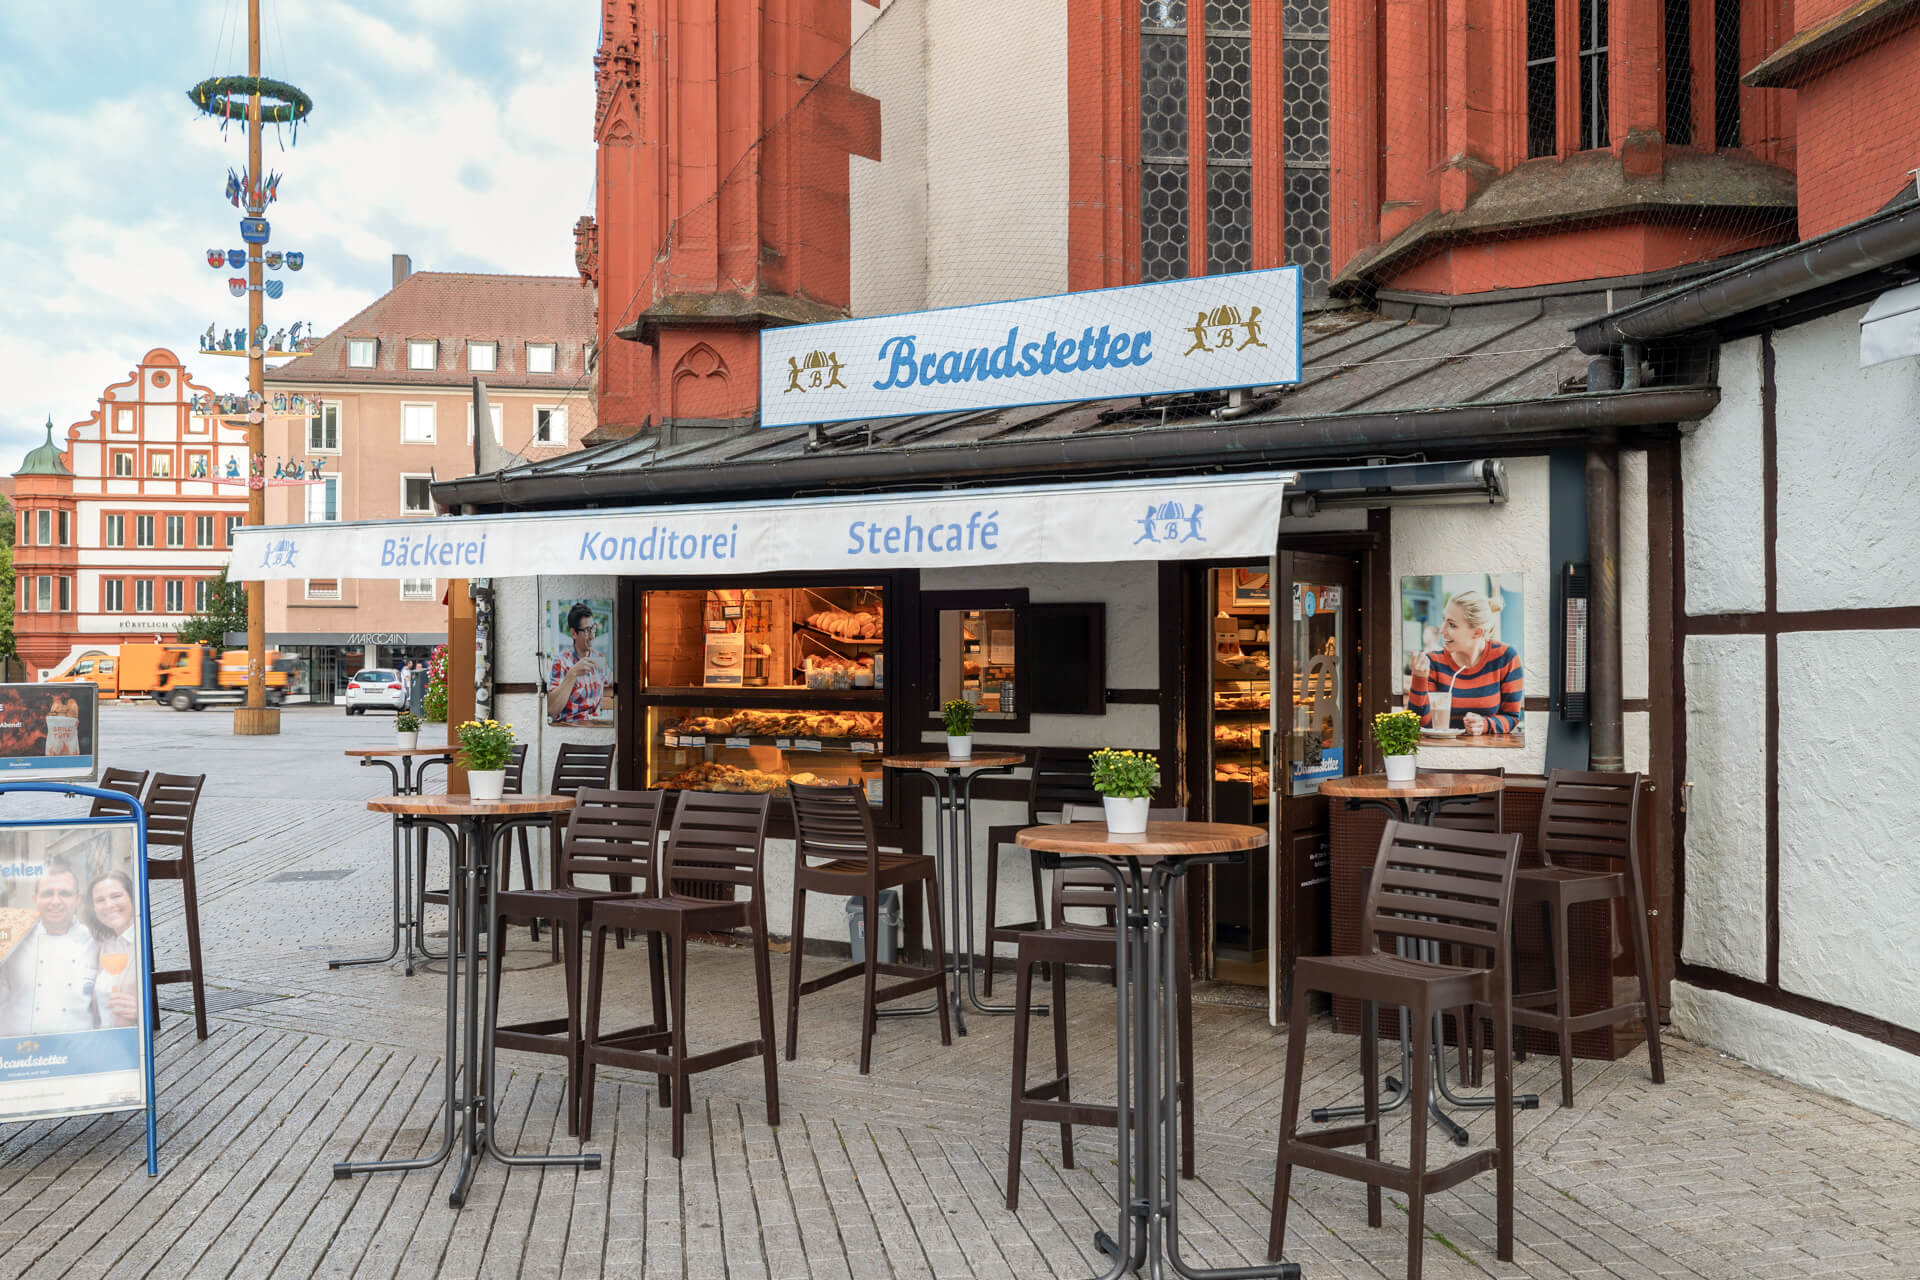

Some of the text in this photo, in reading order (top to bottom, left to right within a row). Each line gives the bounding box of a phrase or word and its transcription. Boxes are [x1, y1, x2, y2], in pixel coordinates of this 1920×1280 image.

[872, 324, 1153, 391] Brandstetter
[579, 523, 739, 561] Konditorei
[847, 509, 1000, 555] Stehcafé
[380, 533, 488, 568] Bäckerei
[0, 863, 43, 878] ehlen
[0, 1054, 69, 1070] randstetter
